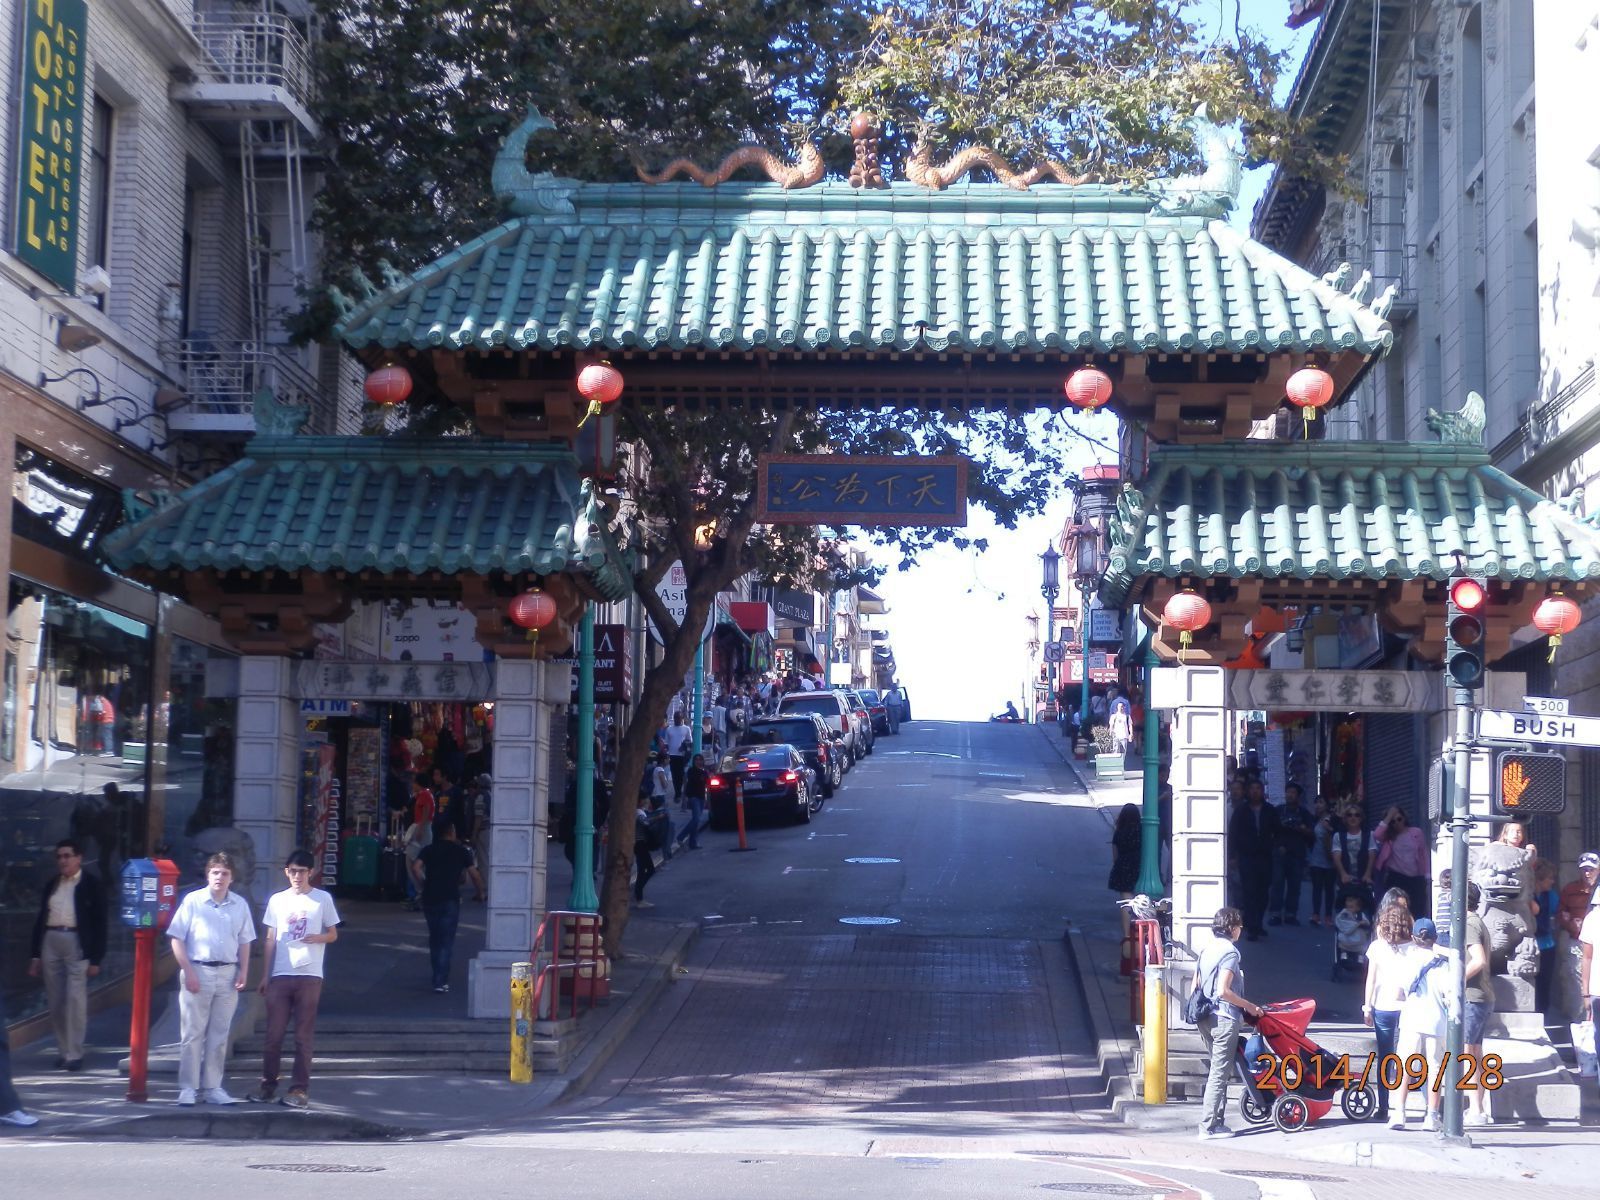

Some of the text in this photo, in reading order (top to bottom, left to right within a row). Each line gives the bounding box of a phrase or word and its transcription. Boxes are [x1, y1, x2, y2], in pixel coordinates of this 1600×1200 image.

[46, 21, 65, 246] ASTORIA
[660, 588, 684, 601] Asi
[777, 601, 810, 621] GRANT PLAZA
[1540, 700, 1564, 712] 500
[1513, 718, 1575, 738] BUSH
